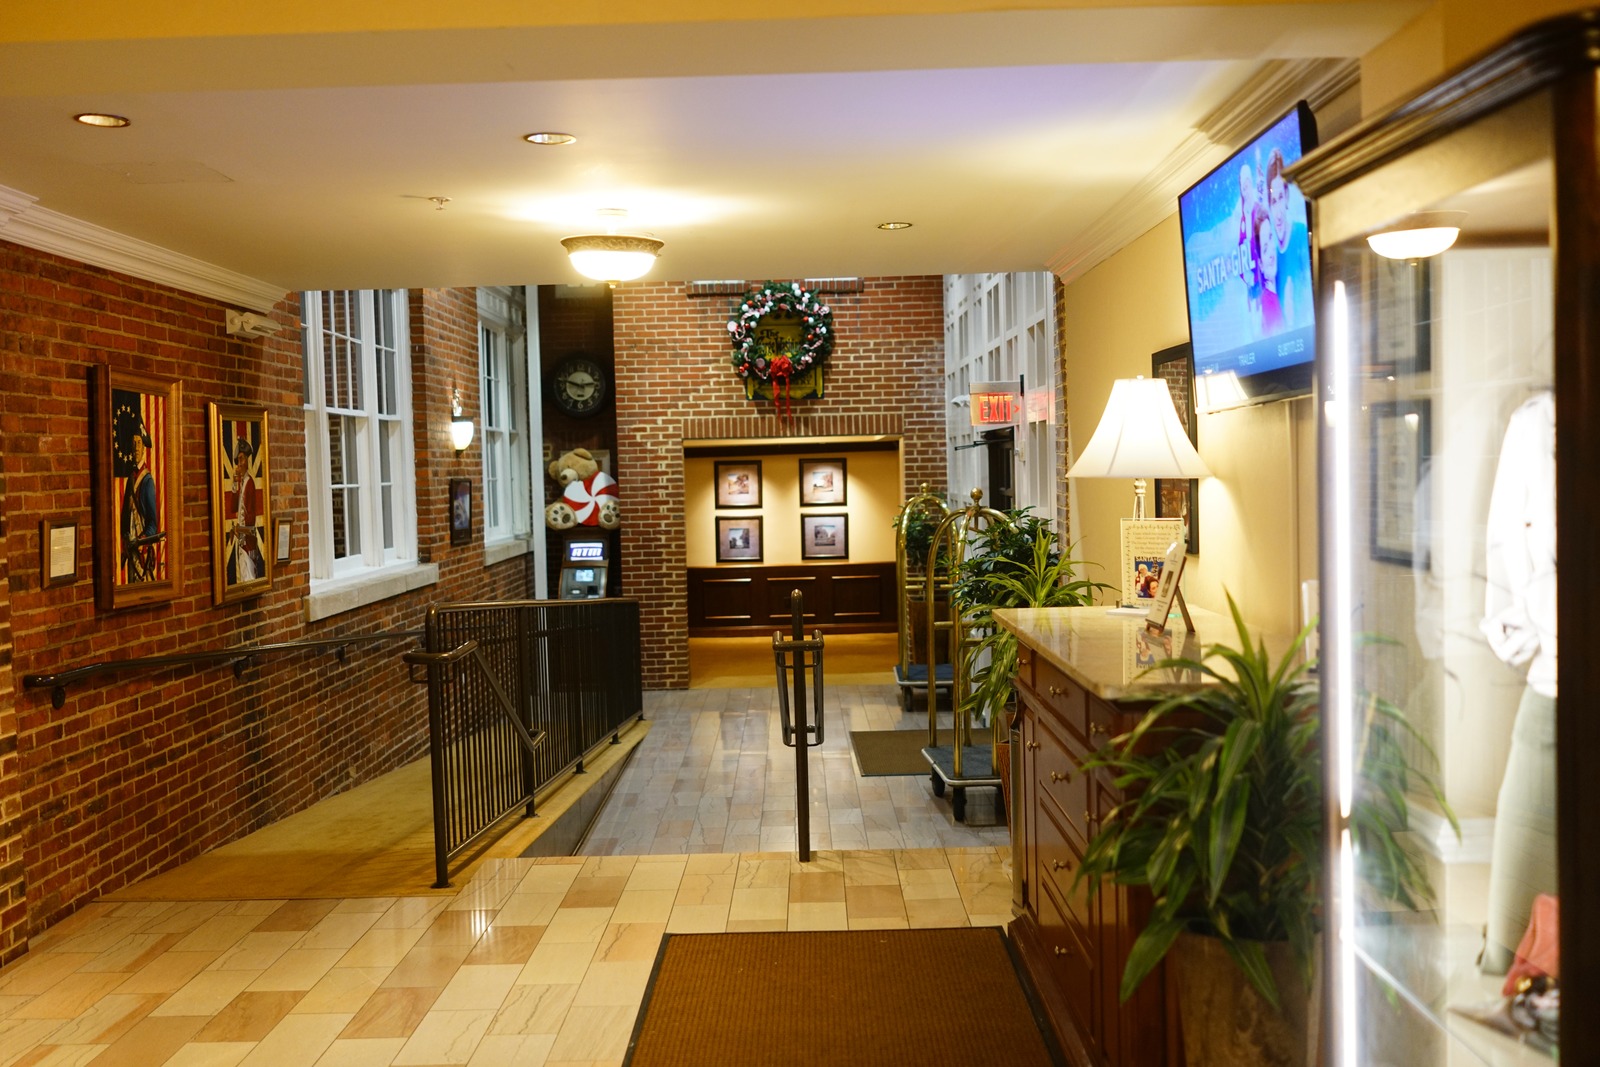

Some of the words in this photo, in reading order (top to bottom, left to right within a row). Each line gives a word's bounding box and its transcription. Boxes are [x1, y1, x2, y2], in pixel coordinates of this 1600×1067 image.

[1197, 256, 1227, 294] SANTA
[1231, 242, 1256, 277] GIRL
[1278, 338, 1305, 357] SUBTITLES
[979, 395, 1013, 422] EXIT
[572, 548, 602, 557] ATM
